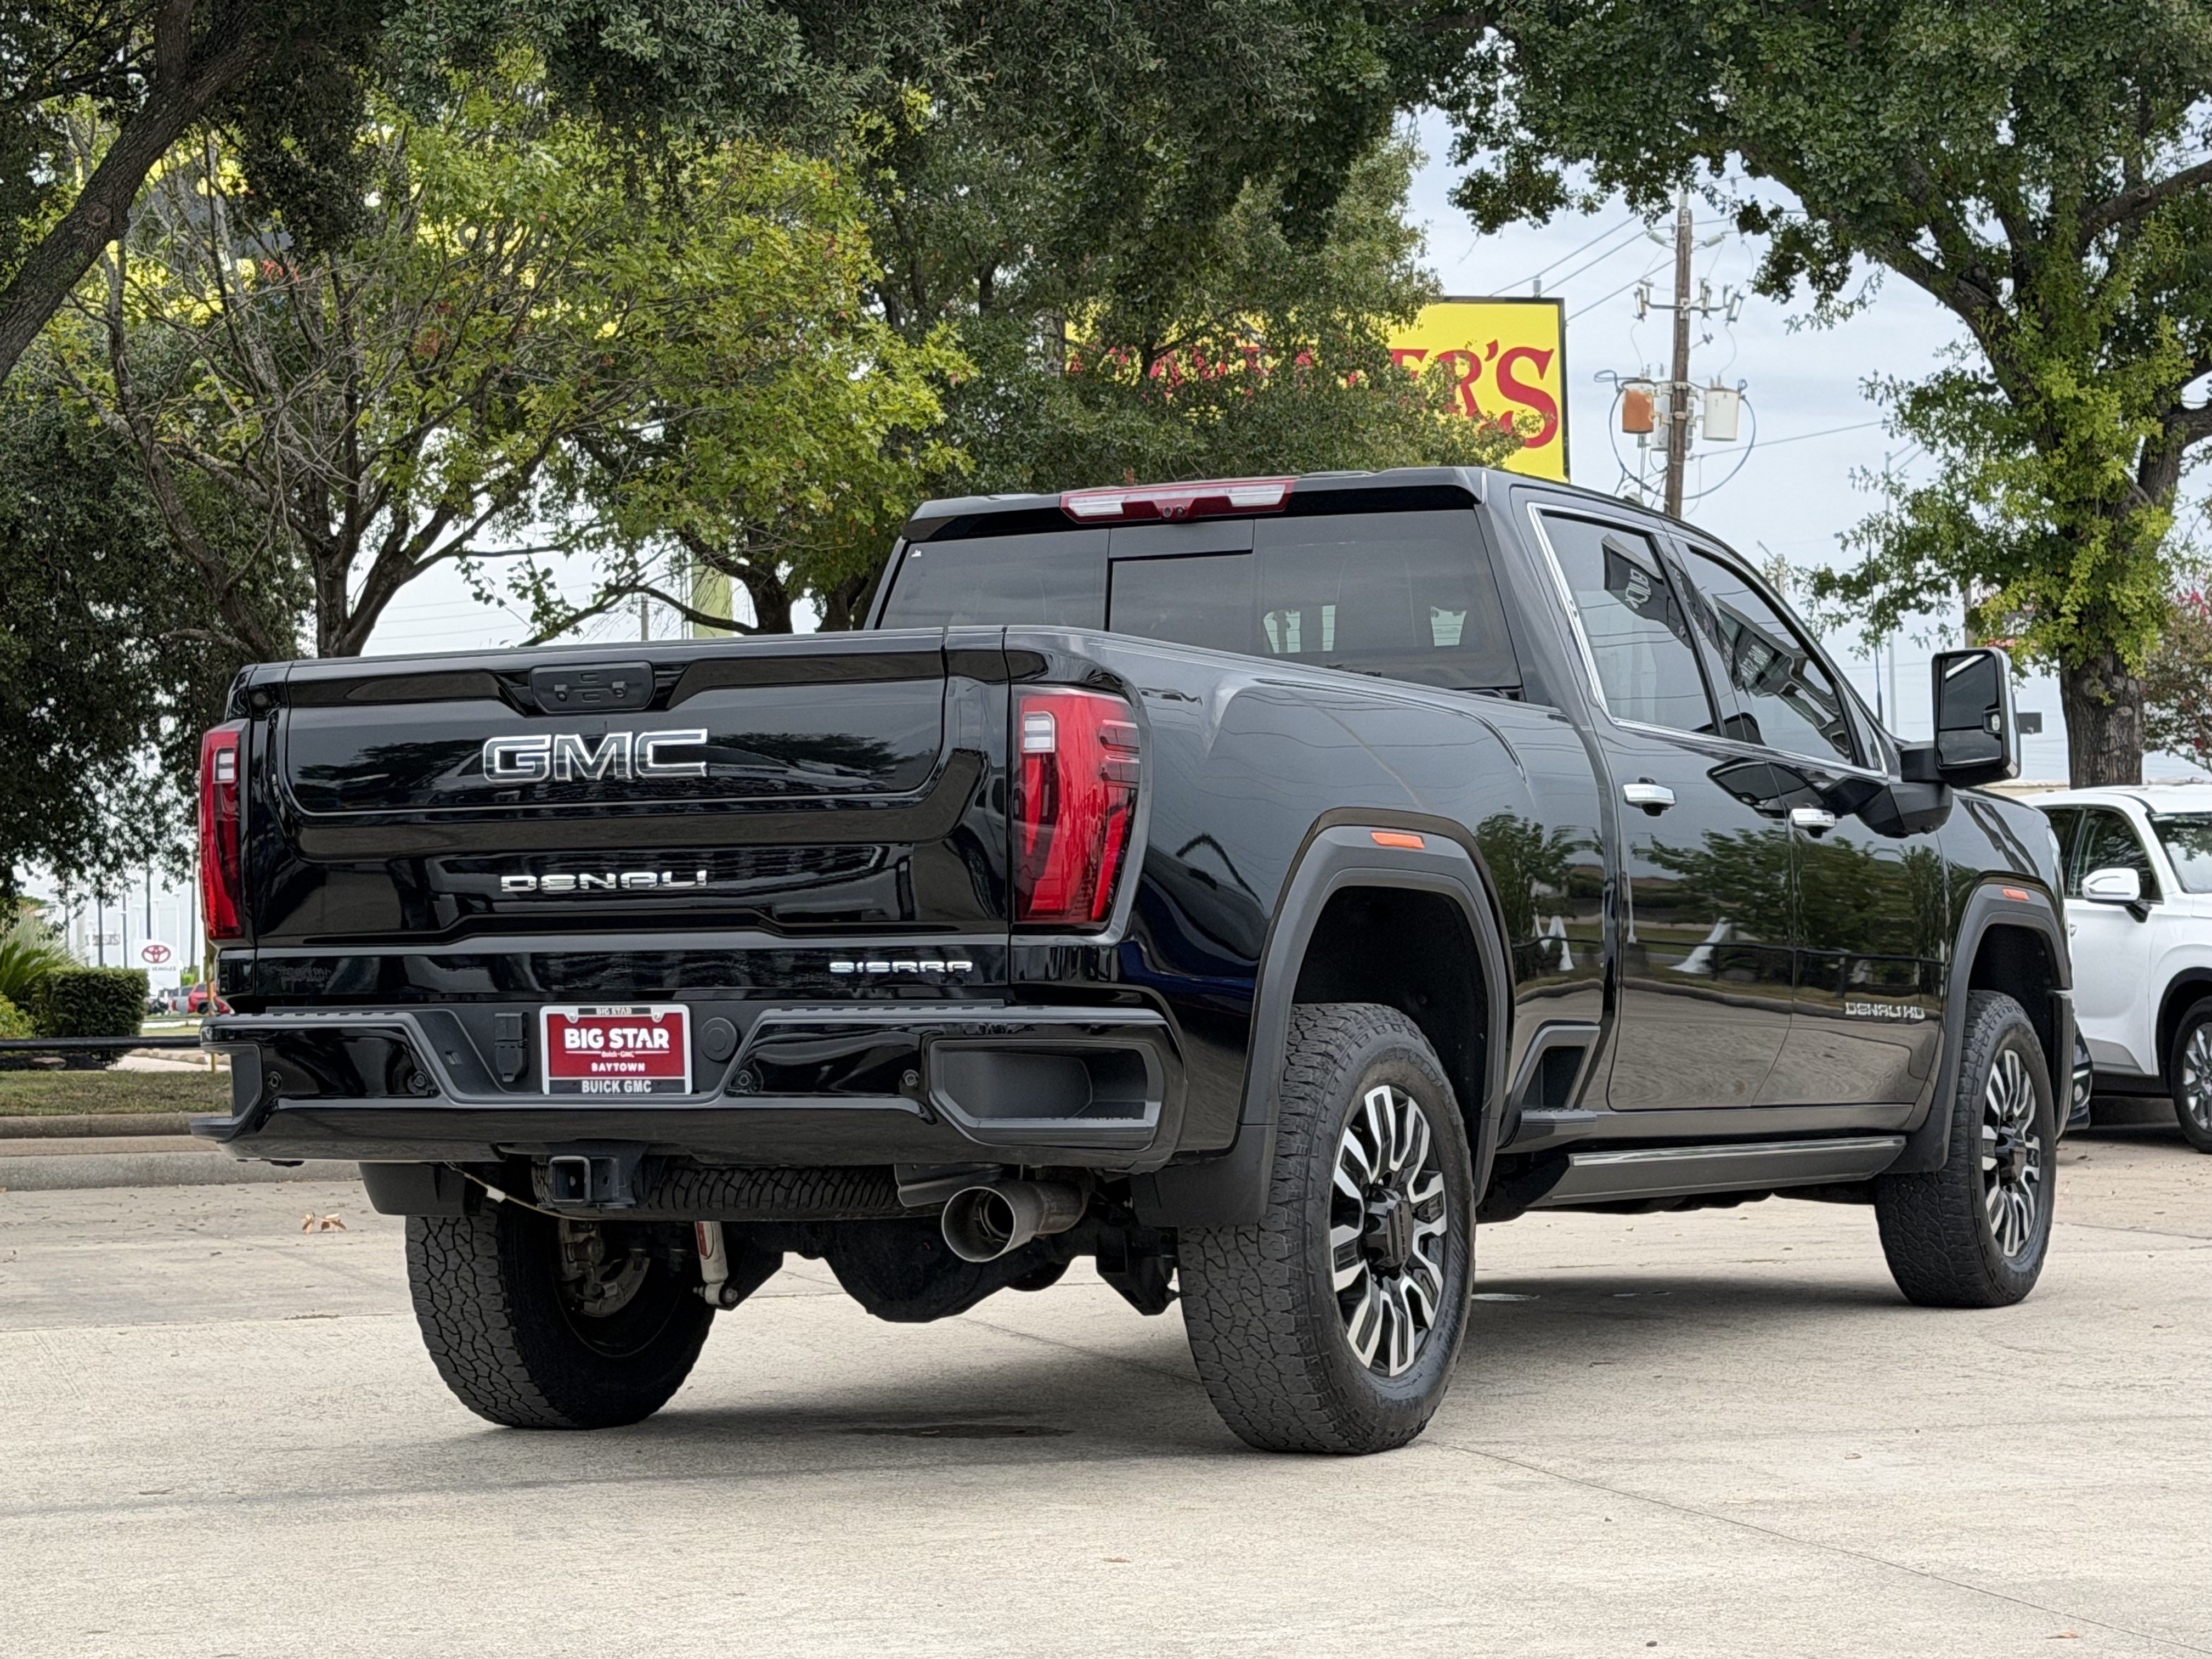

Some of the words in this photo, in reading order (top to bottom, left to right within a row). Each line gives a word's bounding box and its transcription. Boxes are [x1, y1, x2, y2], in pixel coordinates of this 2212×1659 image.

[483, 728, 708, 782] GMC
[501, 870, 707, 893] DENALI
[829, 961, 973, 973] SIERRA
[1845, 1002, 1901, 1017] DENALI
[1903, 1005, 1925, 1019] HD
[563, 1028, 603, 1049] BIG
[609, 1028, 670, 1049] STAR
[591, 1062, 645, 1072] BAYTOWN
[582, 1080, 621, 1093] BUICK
[624, 1079, 652, 1093] GMC
